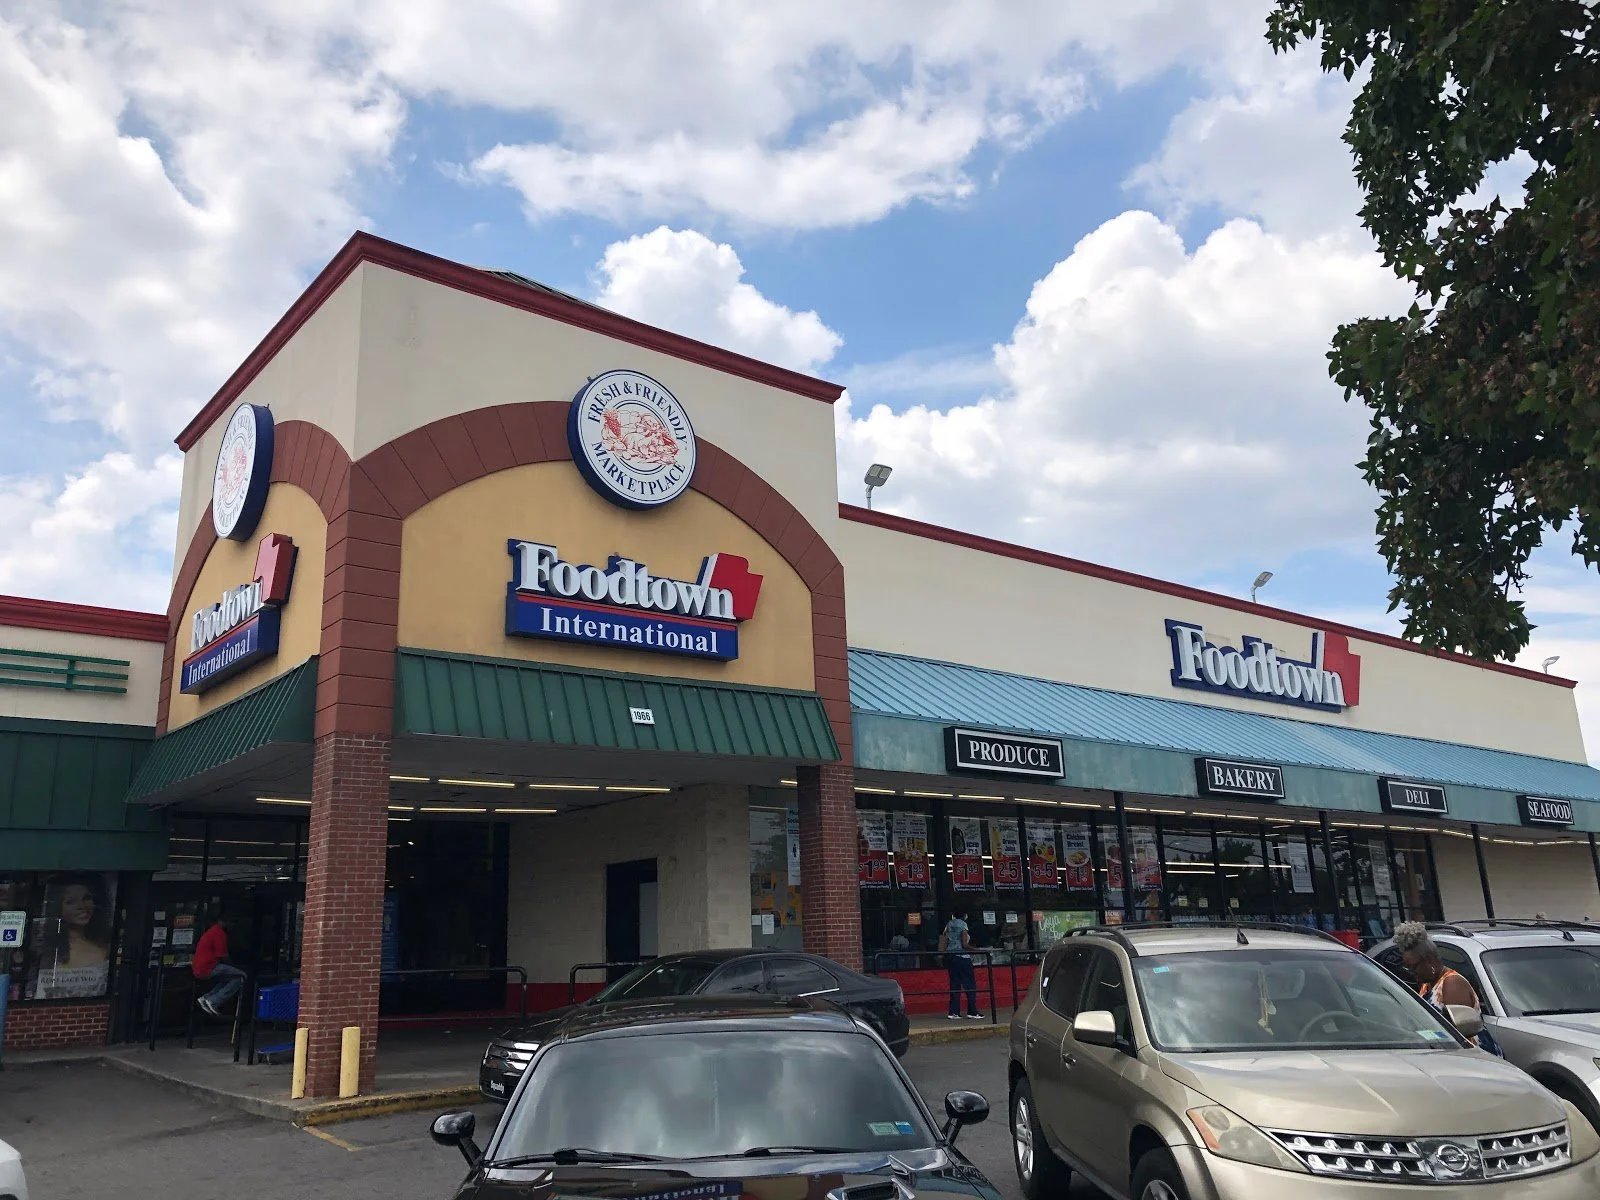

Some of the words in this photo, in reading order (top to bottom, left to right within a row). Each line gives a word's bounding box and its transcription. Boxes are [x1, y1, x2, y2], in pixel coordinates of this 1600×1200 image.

[588, 382, 621, 424] FRESH
[623, 381, 633, 395] &
[635, 382, 689, 446] FRIENDLY
[592, 441, 686, 495] MARKETPLACE
[516, 541, 737, 621] Foodtown
[189, 578, 265, 655] Foodtown
[540, 607, 718, 654] International
[187, 629, 251, 687] International
[1172, 625, 1347, 706] Foodtown
[969, 740, 1050, 767] PRODUCE
[1212, 765, 1276, 791] BAKERY
[1405, 789, 1430, 805] DELI
[1527, 801, 1571, 820] SEAFOOD
